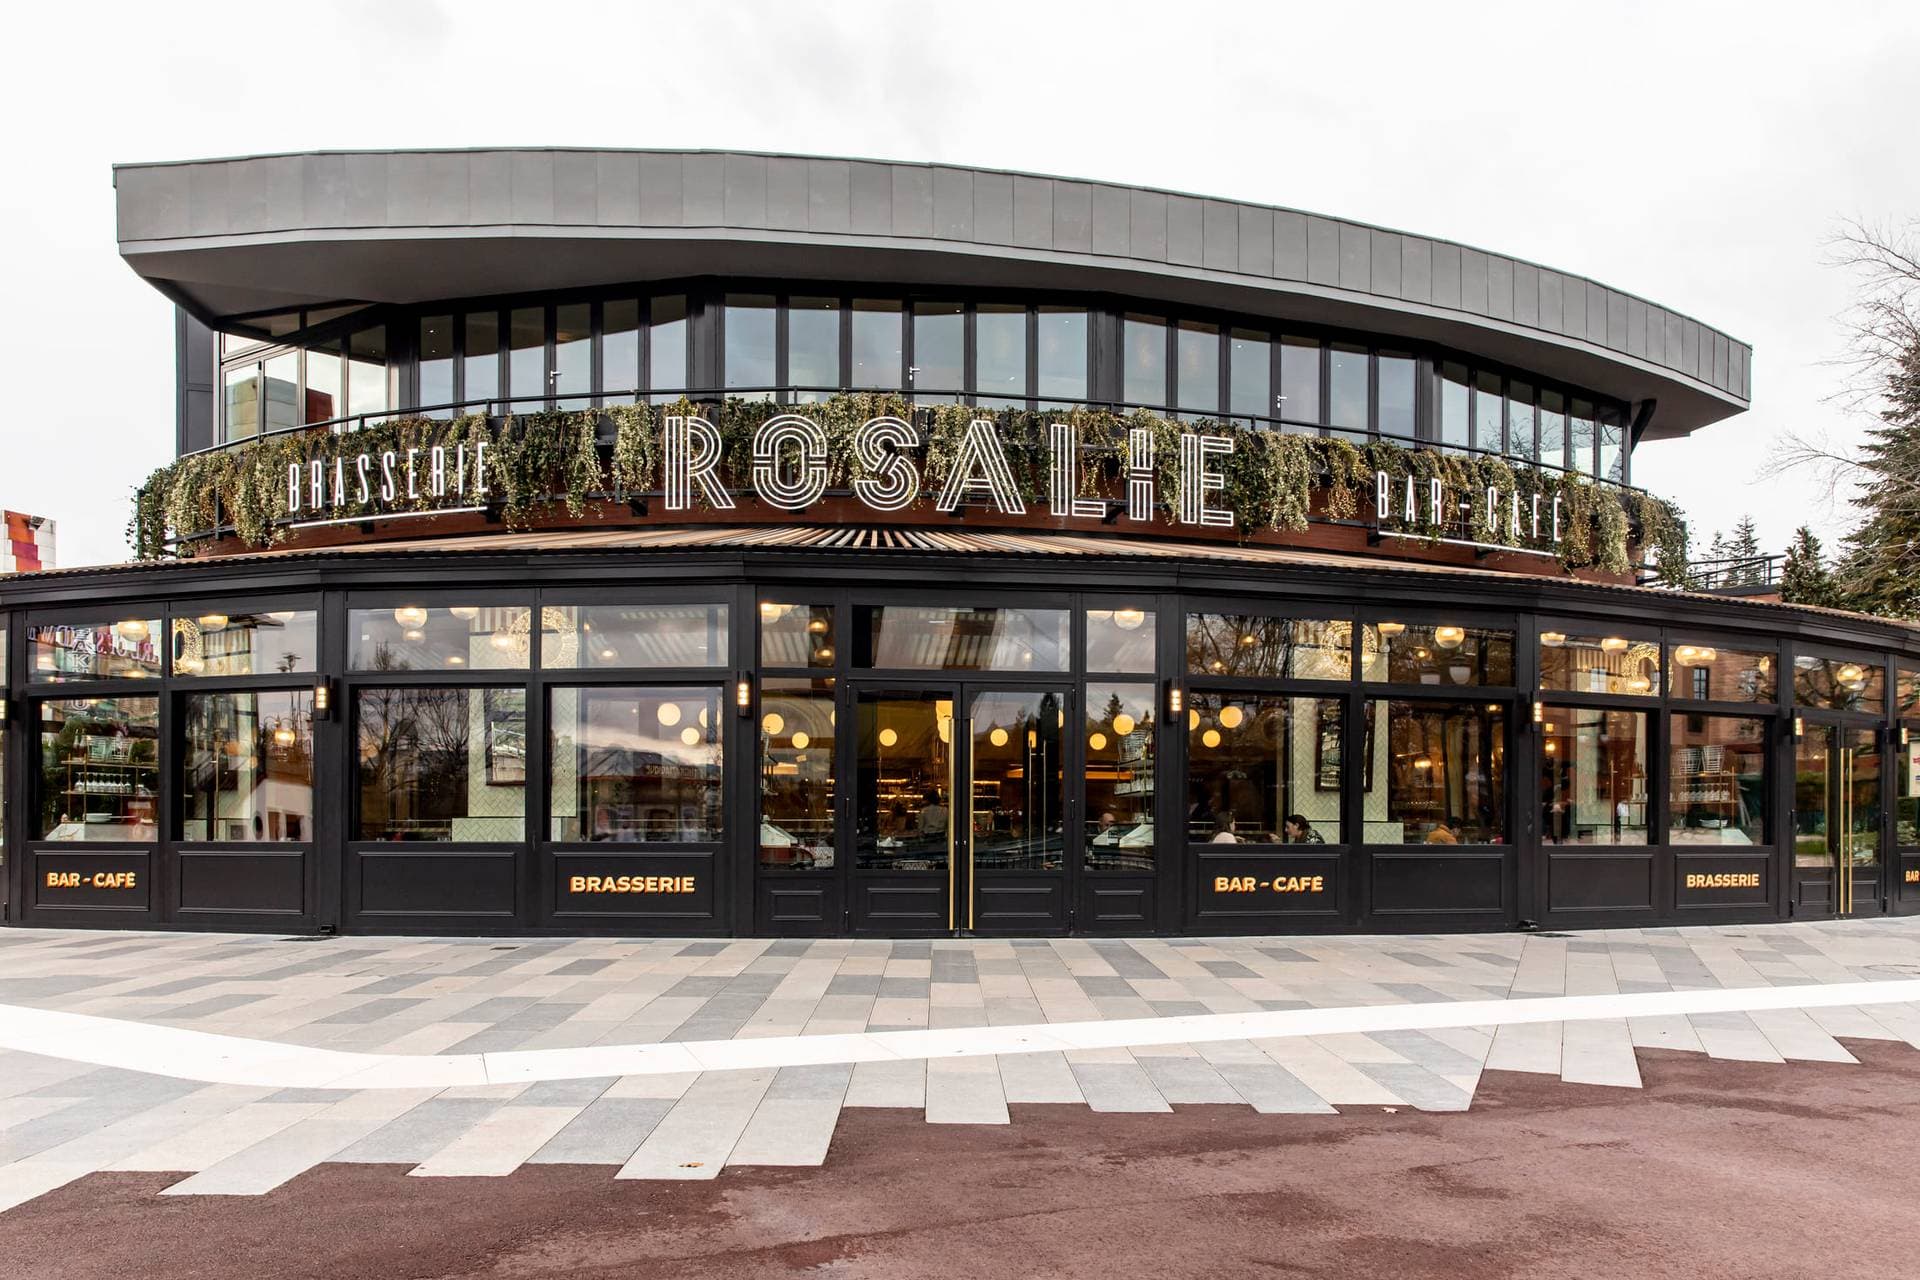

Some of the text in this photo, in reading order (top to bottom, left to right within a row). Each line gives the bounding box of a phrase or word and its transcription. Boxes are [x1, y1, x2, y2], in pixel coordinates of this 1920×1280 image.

[288, 441, 489, 512] BRASSERIE
[664, 414, 1235, 528] ROSALIE
[569, 876, 695, 893] BRASSERIE
[1686, 873, 1760, 888] BRASSERIE
